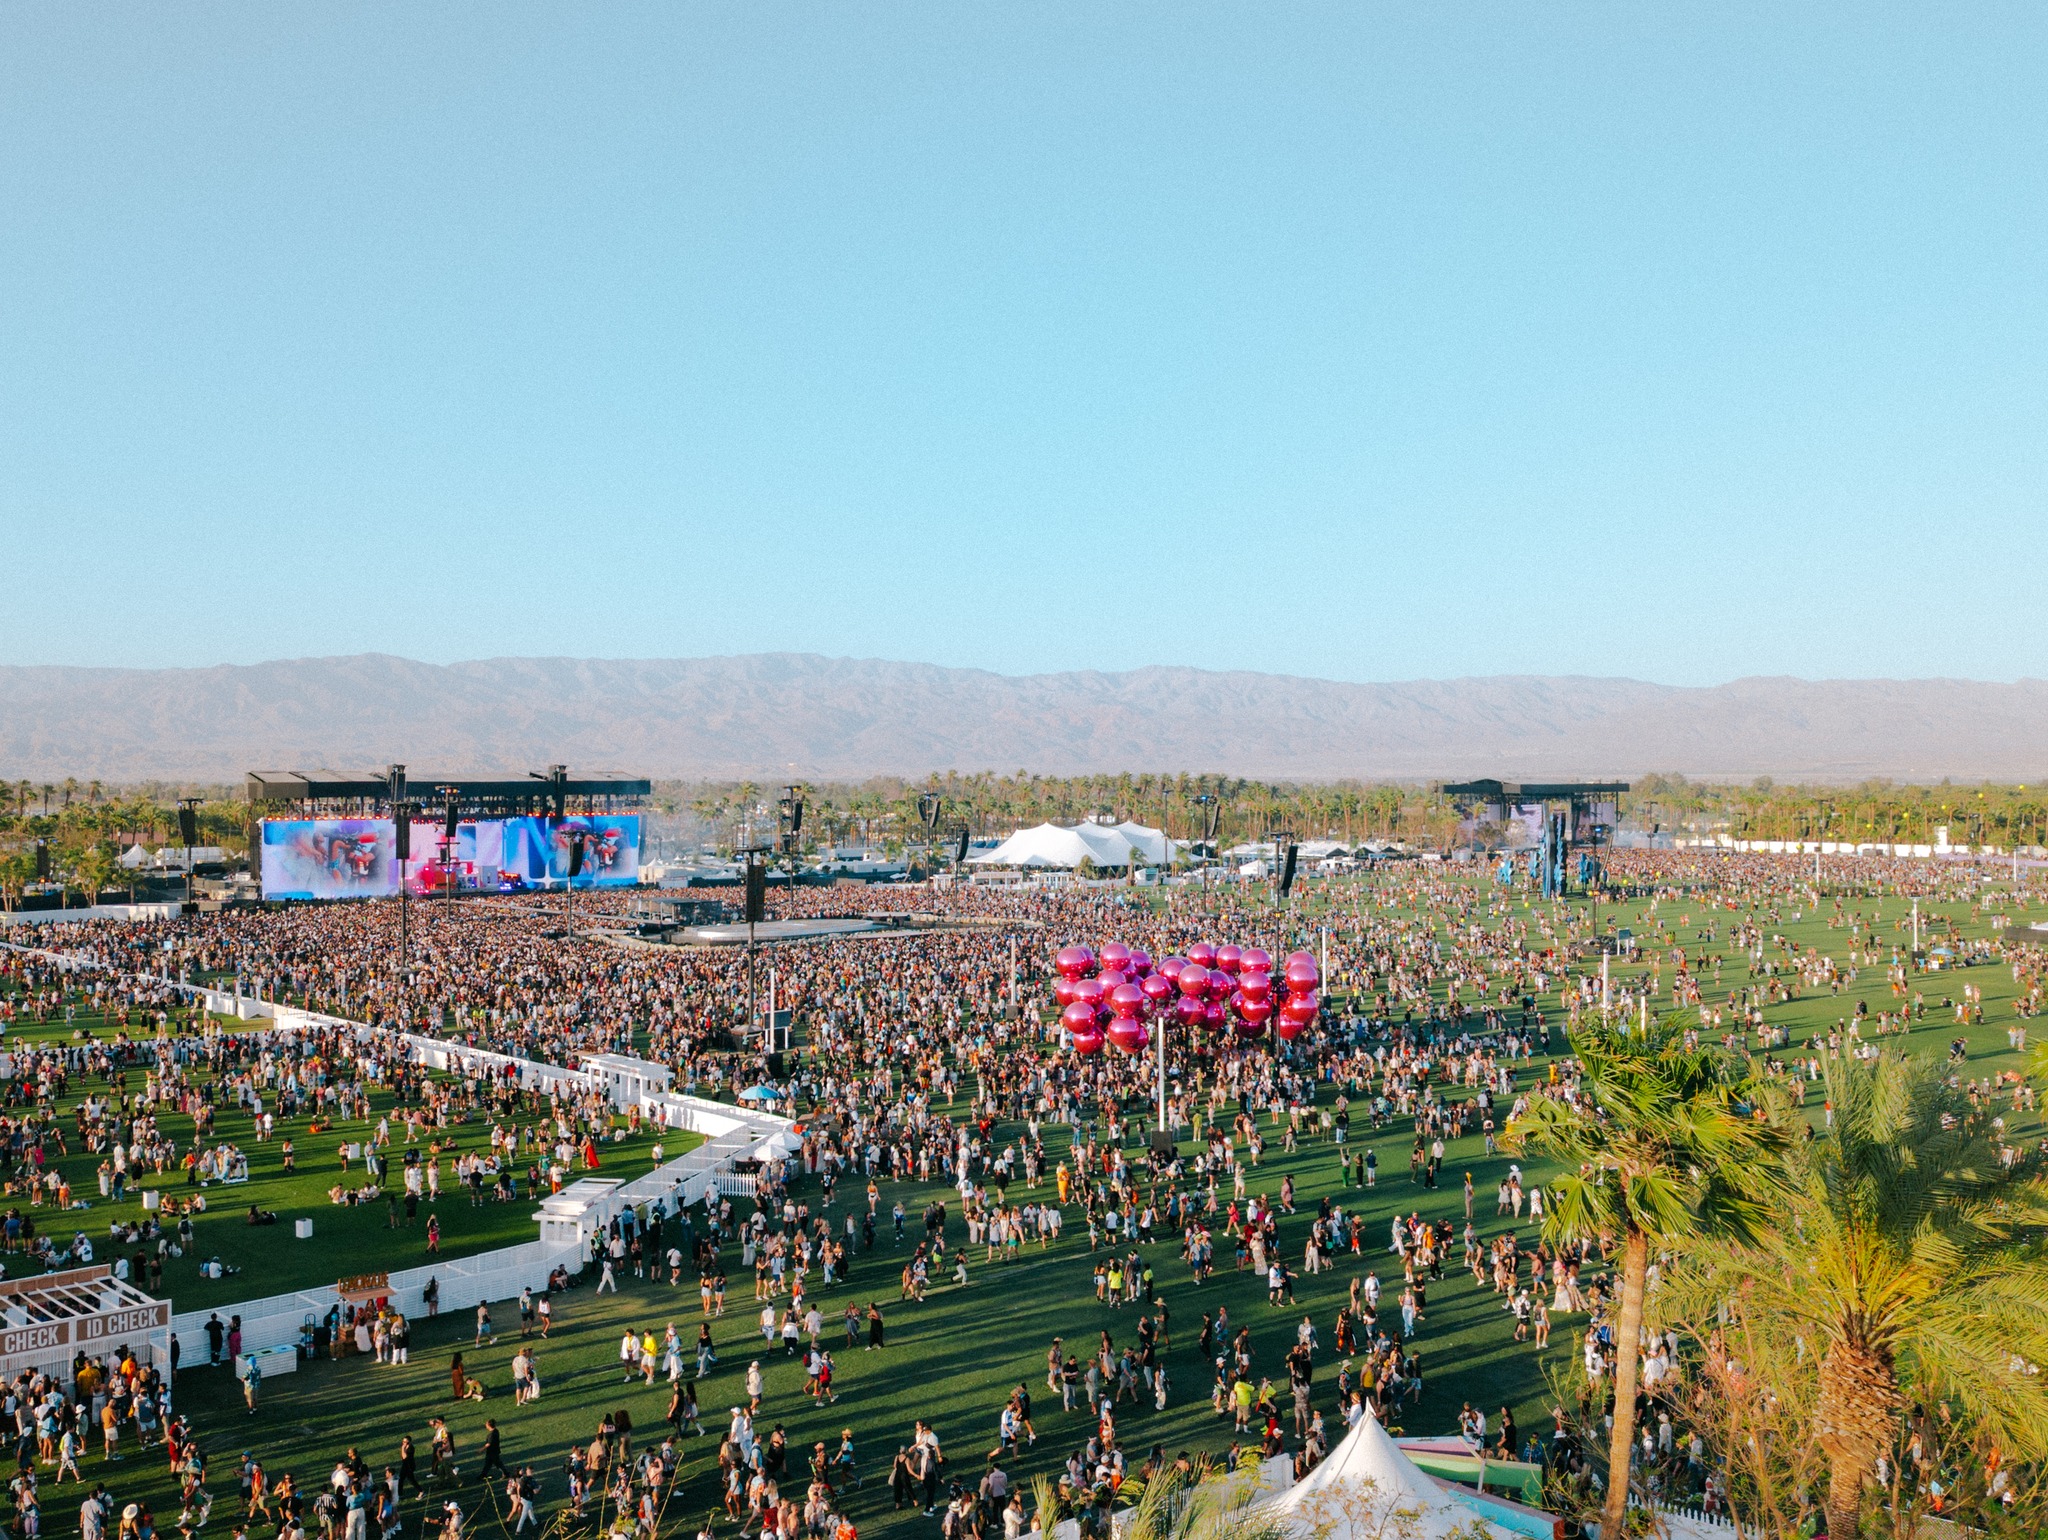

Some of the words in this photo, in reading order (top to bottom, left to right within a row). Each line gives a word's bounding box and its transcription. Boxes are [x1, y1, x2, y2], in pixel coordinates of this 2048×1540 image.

[86, 1318, 103, 1338] ID
[107, 1307, 159, 1334] CHECK
[5, 1325, 59, 1353] CHECK
